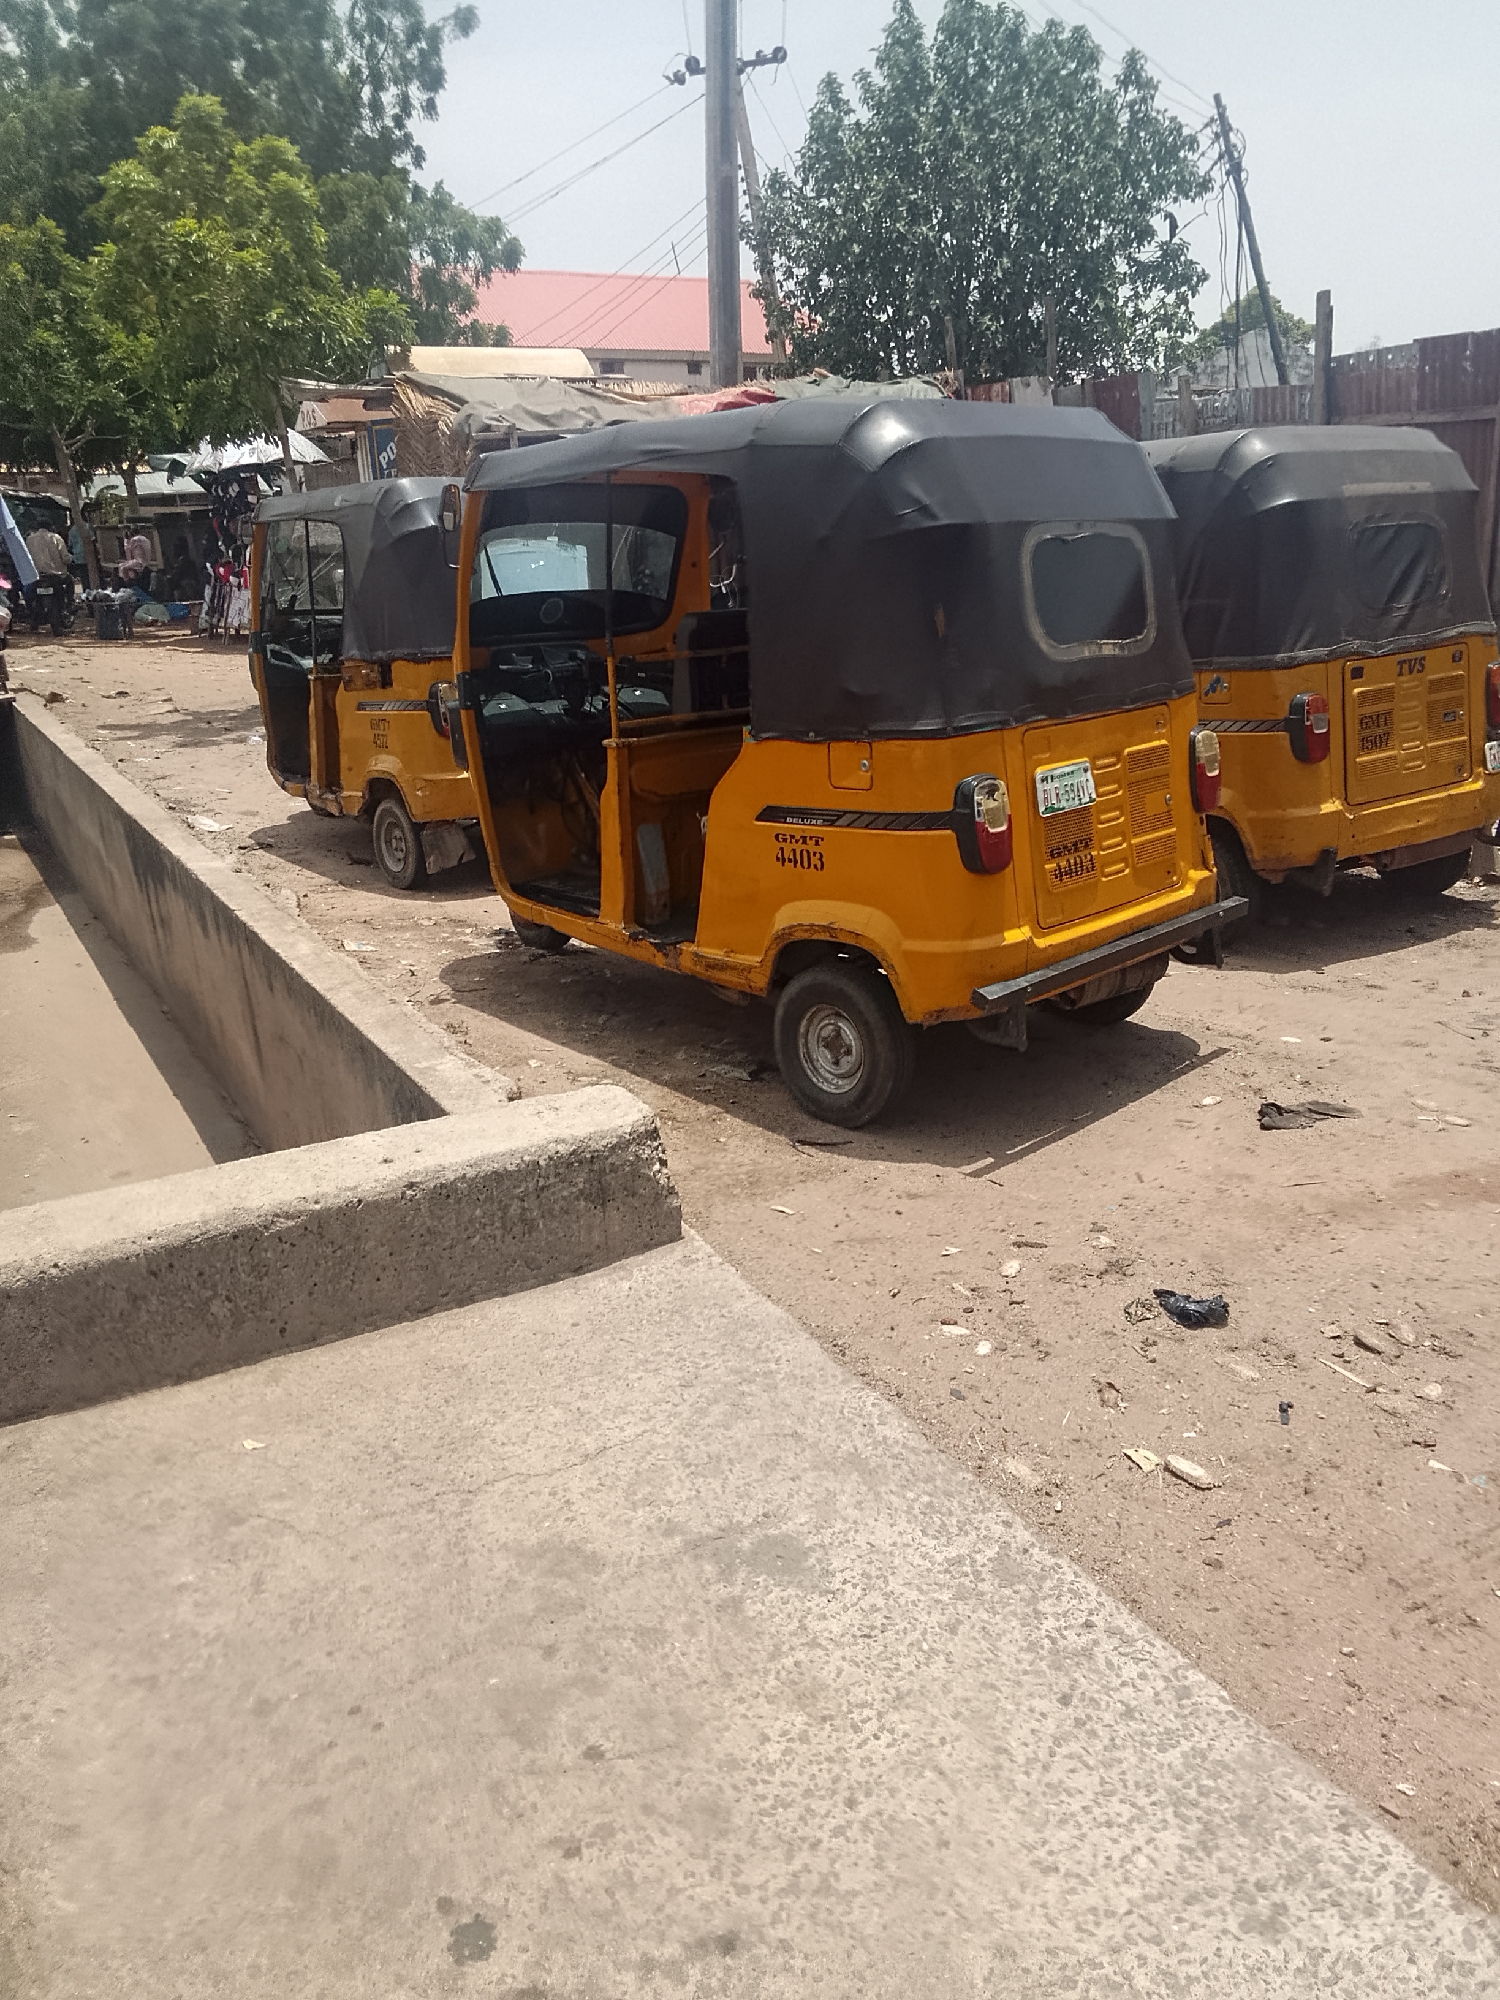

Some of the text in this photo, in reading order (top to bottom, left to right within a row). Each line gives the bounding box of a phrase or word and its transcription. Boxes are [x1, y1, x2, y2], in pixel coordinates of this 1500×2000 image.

[378, 441, 398, 469] PO
[1396, 655, 1427, 677] TVS
[785, 816, 825, 825] DELUXE
[774, 832, 825, 847] GMT
[775, 847, 825, 872] 4403
